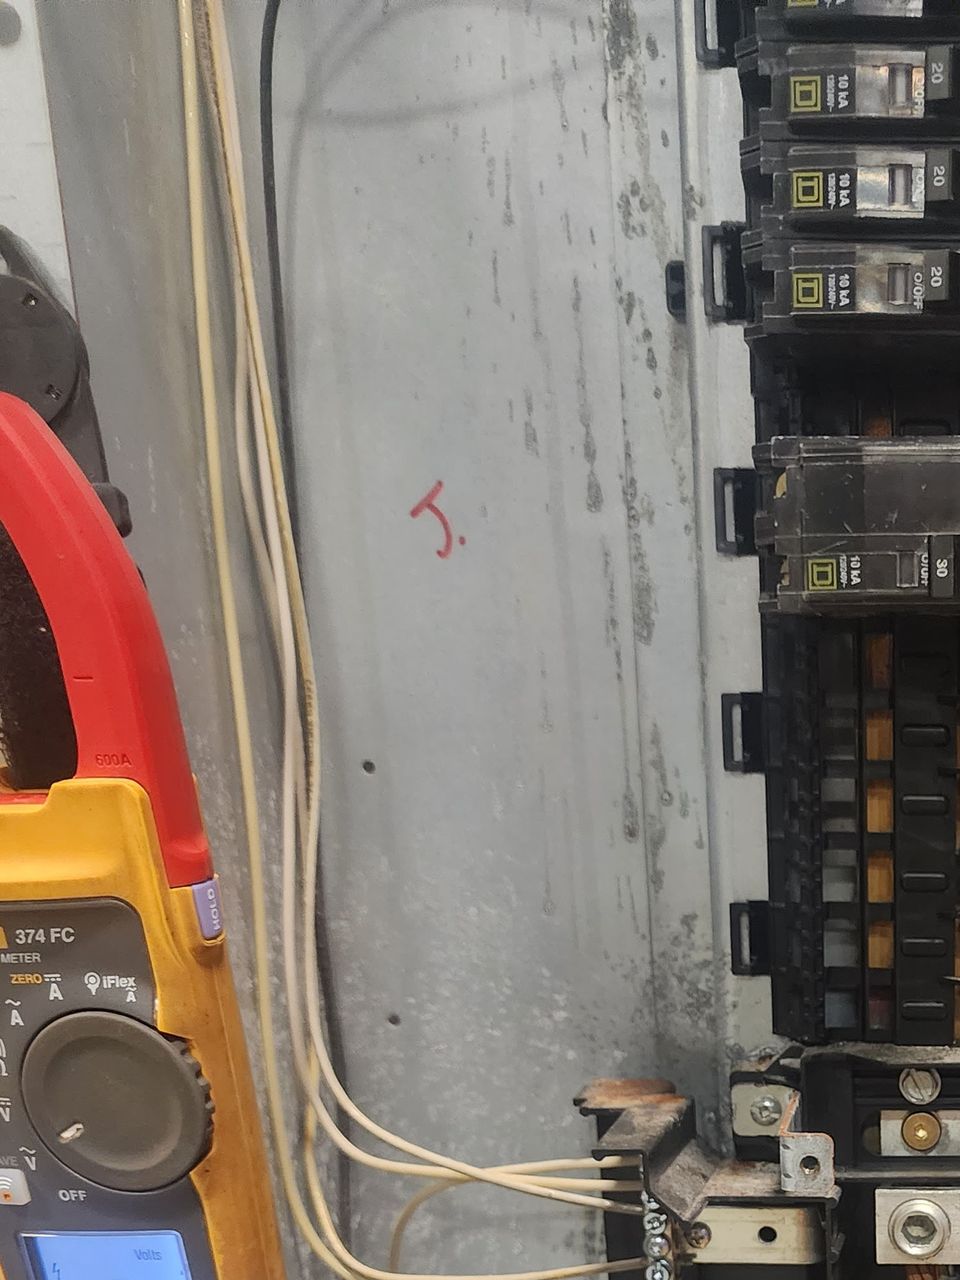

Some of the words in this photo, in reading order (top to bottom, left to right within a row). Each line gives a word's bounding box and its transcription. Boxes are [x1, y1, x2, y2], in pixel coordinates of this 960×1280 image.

[931, 62, 944, 84] 20
[838, 75, 849, 89] 10
[838, 91, 849, 109] kA
[839, 173, 850, 188] 10
[933, 166, 945, 187] 20
[839, 190, 850, 208] kA
[839, 274, 850, 289] 10
[930, 266, 943, 288] 20
[913, 272, 924, 310] O/OFF
[839, 291, 850, 307] kA
[850, 555, 861, 569] 10
[851, 571, 862, 586] kA
[95, 753, 132, 767] 600A
[207, 888, 222, 930] HOLD
[15, 929, 46, 944] 374
[50, 927, 75, 943] FC
[0, 953, 41, 963] METER
[10, 974, 42, 984] ZERO
[102, 975, 136, 989] iFlex
[49, 983, 64, 1001] A
[58, 1189, 87, 1202] OFF
[133, 1248, 162, 1261] Volts
